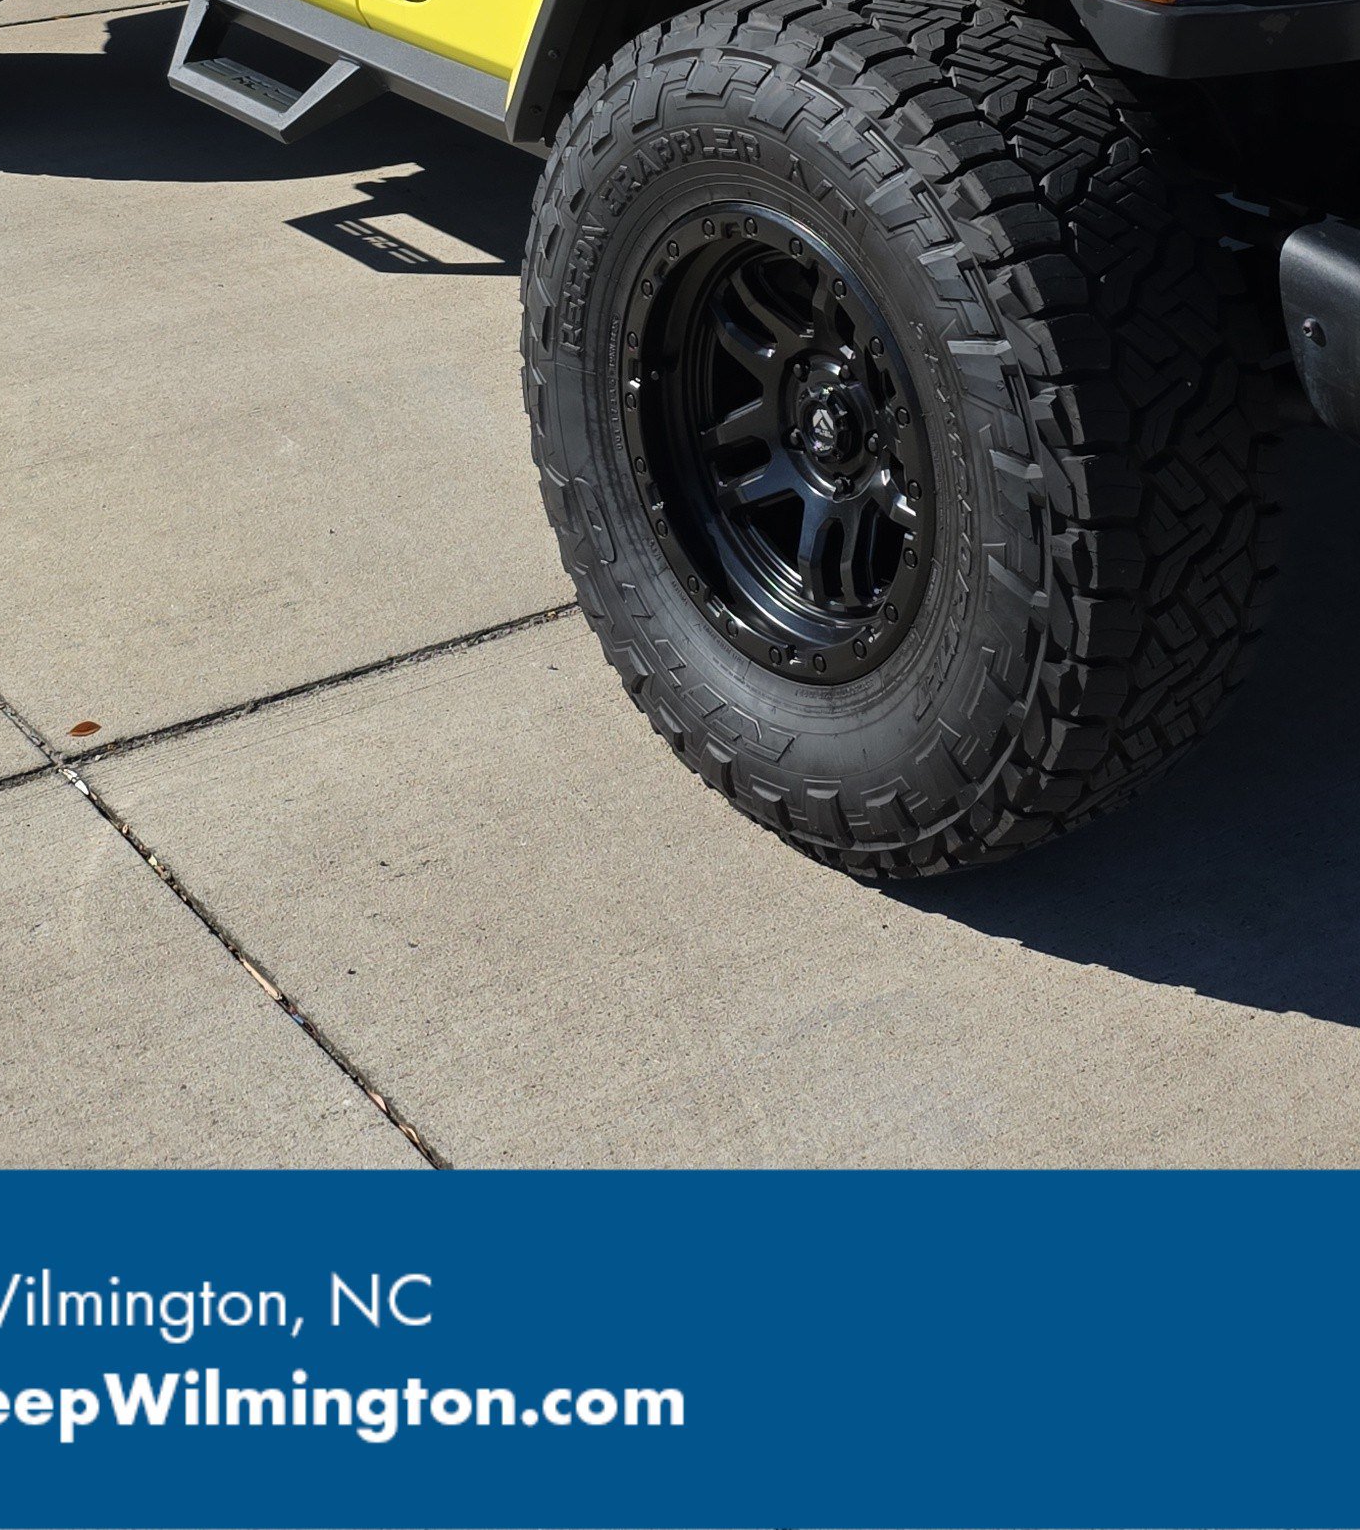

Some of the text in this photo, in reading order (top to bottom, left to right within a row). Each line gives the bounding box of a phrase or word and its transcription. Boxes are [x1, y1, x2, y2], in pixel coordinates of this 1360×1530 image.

[559, 126, 858, 357] RECON GRAPPLER A/T
